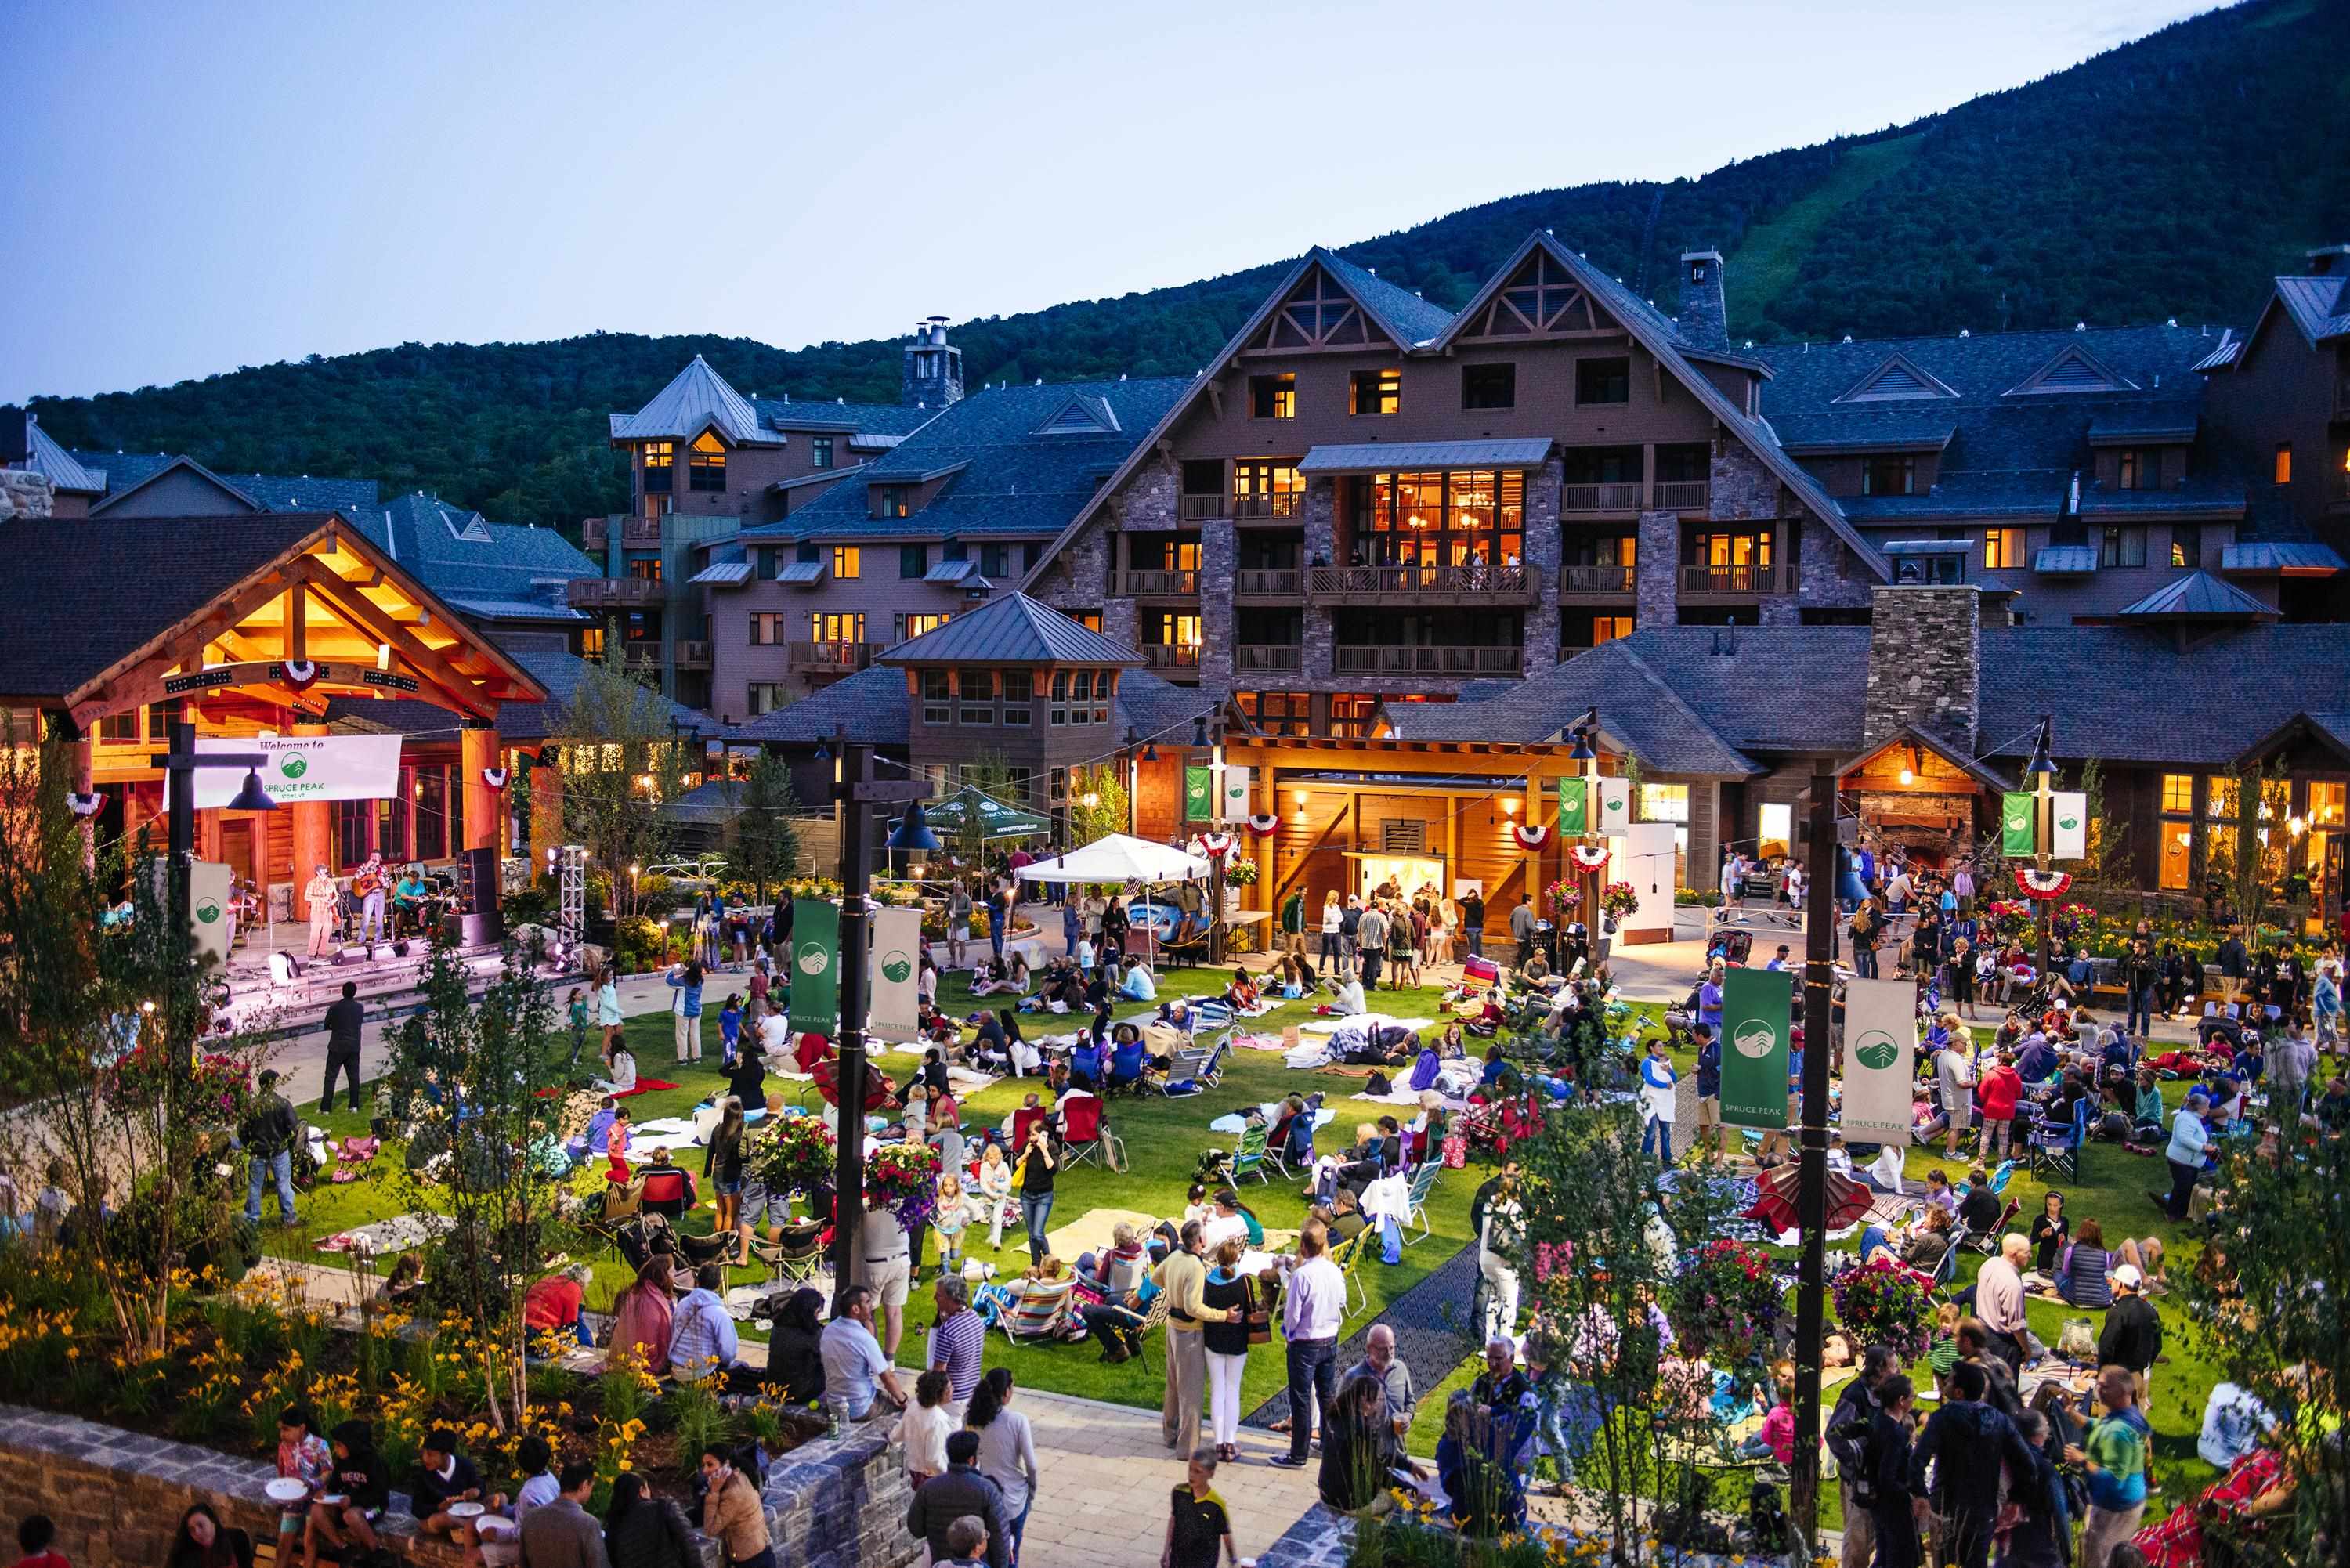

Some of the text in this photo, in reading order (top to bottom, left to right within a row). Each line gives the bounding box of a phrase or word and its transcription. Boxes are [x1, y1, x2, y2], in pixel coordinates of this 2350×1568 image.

[260, 740, 324, 750] Welcome to
[264, 782, 324, 793] SPRUCE PEAK
[1725, 1104, 1781, 1116] SPRUCE PEAK
[1846, 1119, 1904, 1131] SPRUCE PEAK
